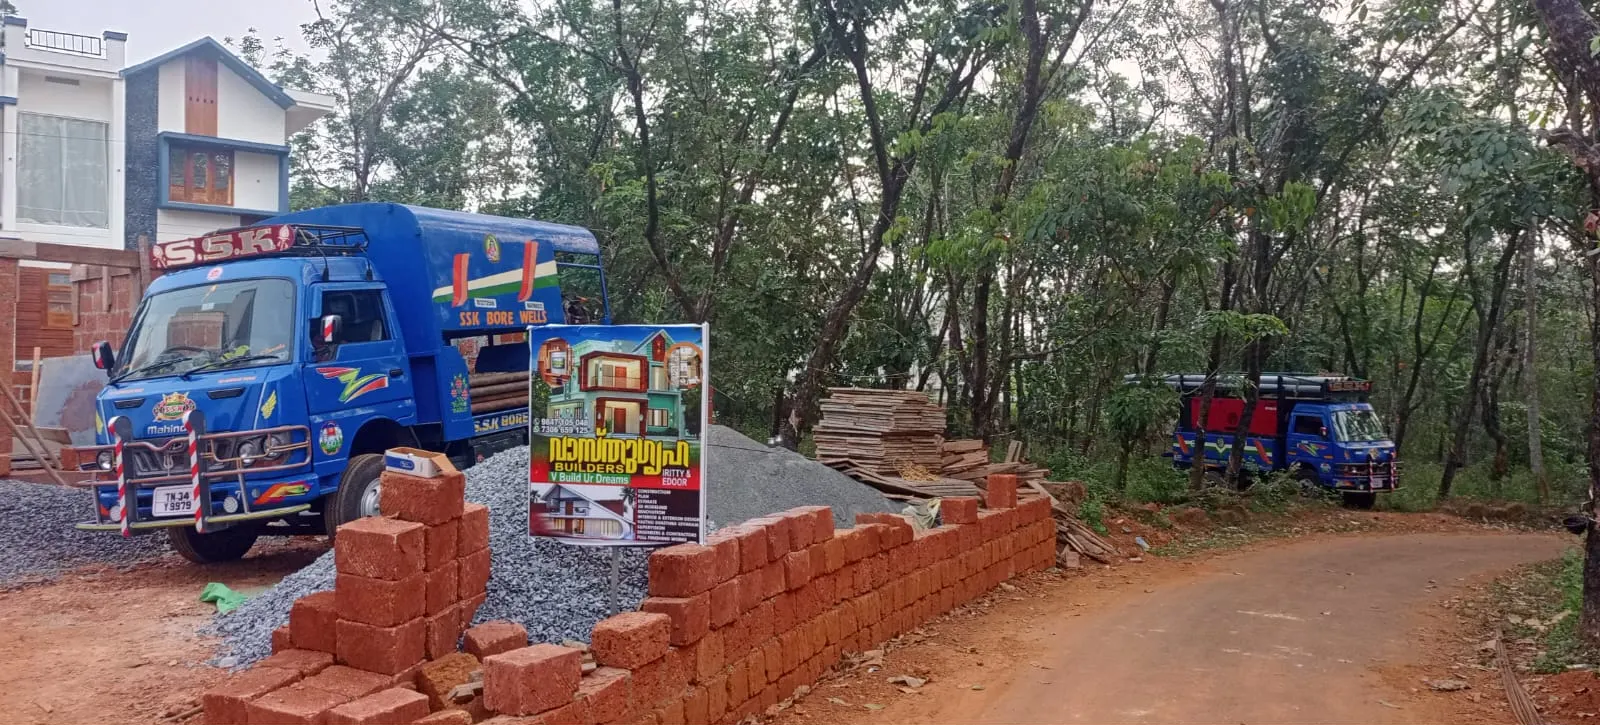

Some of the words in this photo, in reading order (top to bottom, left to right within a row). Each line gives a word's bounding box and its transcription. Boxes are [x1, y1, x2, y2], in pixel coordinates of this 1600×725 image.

[164, 227, 276, 266] S.S.K
[460, 311, 480, 326] SSK
[486, 311, 514, 325] BORE
[519, 310, 548, 324] WELLS
[501, 412, 528, 426] BORE
[147, 424, 187, 435] Mahind
[555, 462, 624, 474] BUILDERS
[662, 468, 685, 478] IRITTY
[686, 469, 692, 478] &
[551, 472, 557, 481] V
[559, 472, 582, 482] Build
[583, 473, 593, 482] Ur
[596, 474, 629, 484] Dreams
[662, 477, 688, 487] EDOOR
